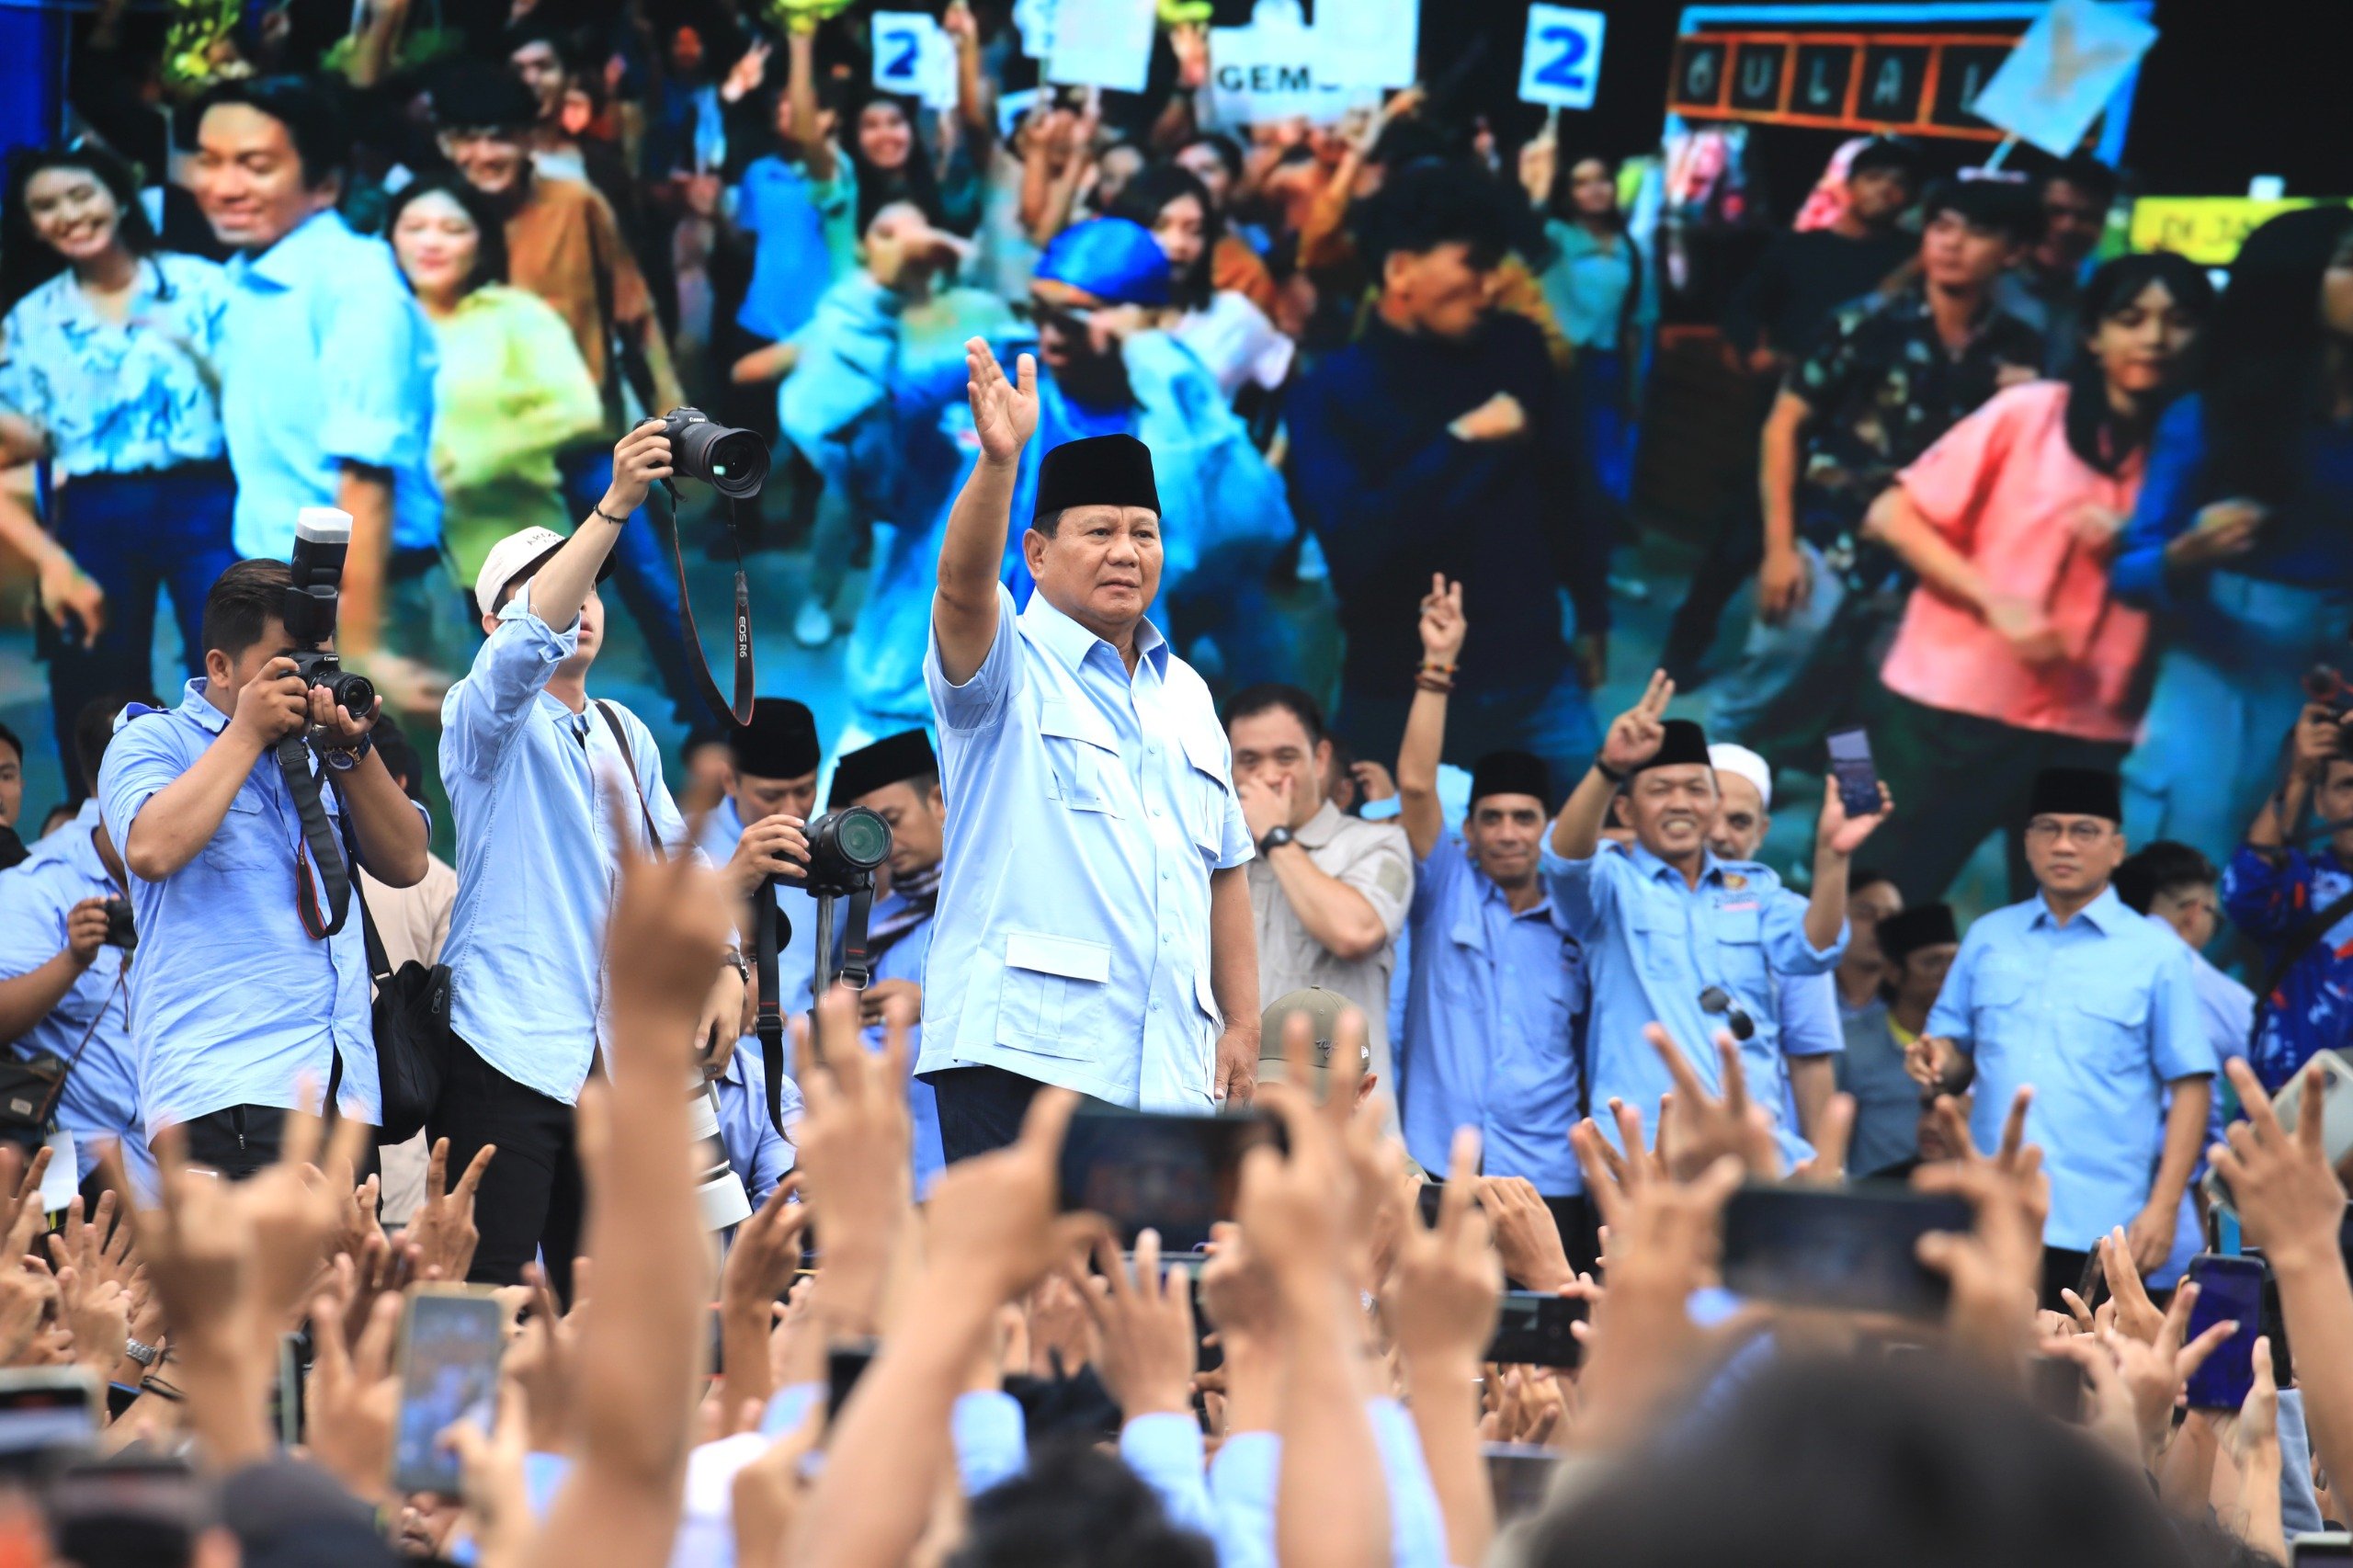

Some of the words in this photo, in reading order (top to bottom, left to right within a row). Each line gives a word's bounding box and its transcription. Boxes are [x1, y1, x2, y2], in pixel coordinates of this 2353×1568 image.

[883, 30, 919, 77] 2
[1534, 26, 1589, 89] 2
[1217, 64, 1340, 93] GEM
[738, 616, 747, 642] EOS
[739, 643, 747, 658] R6
